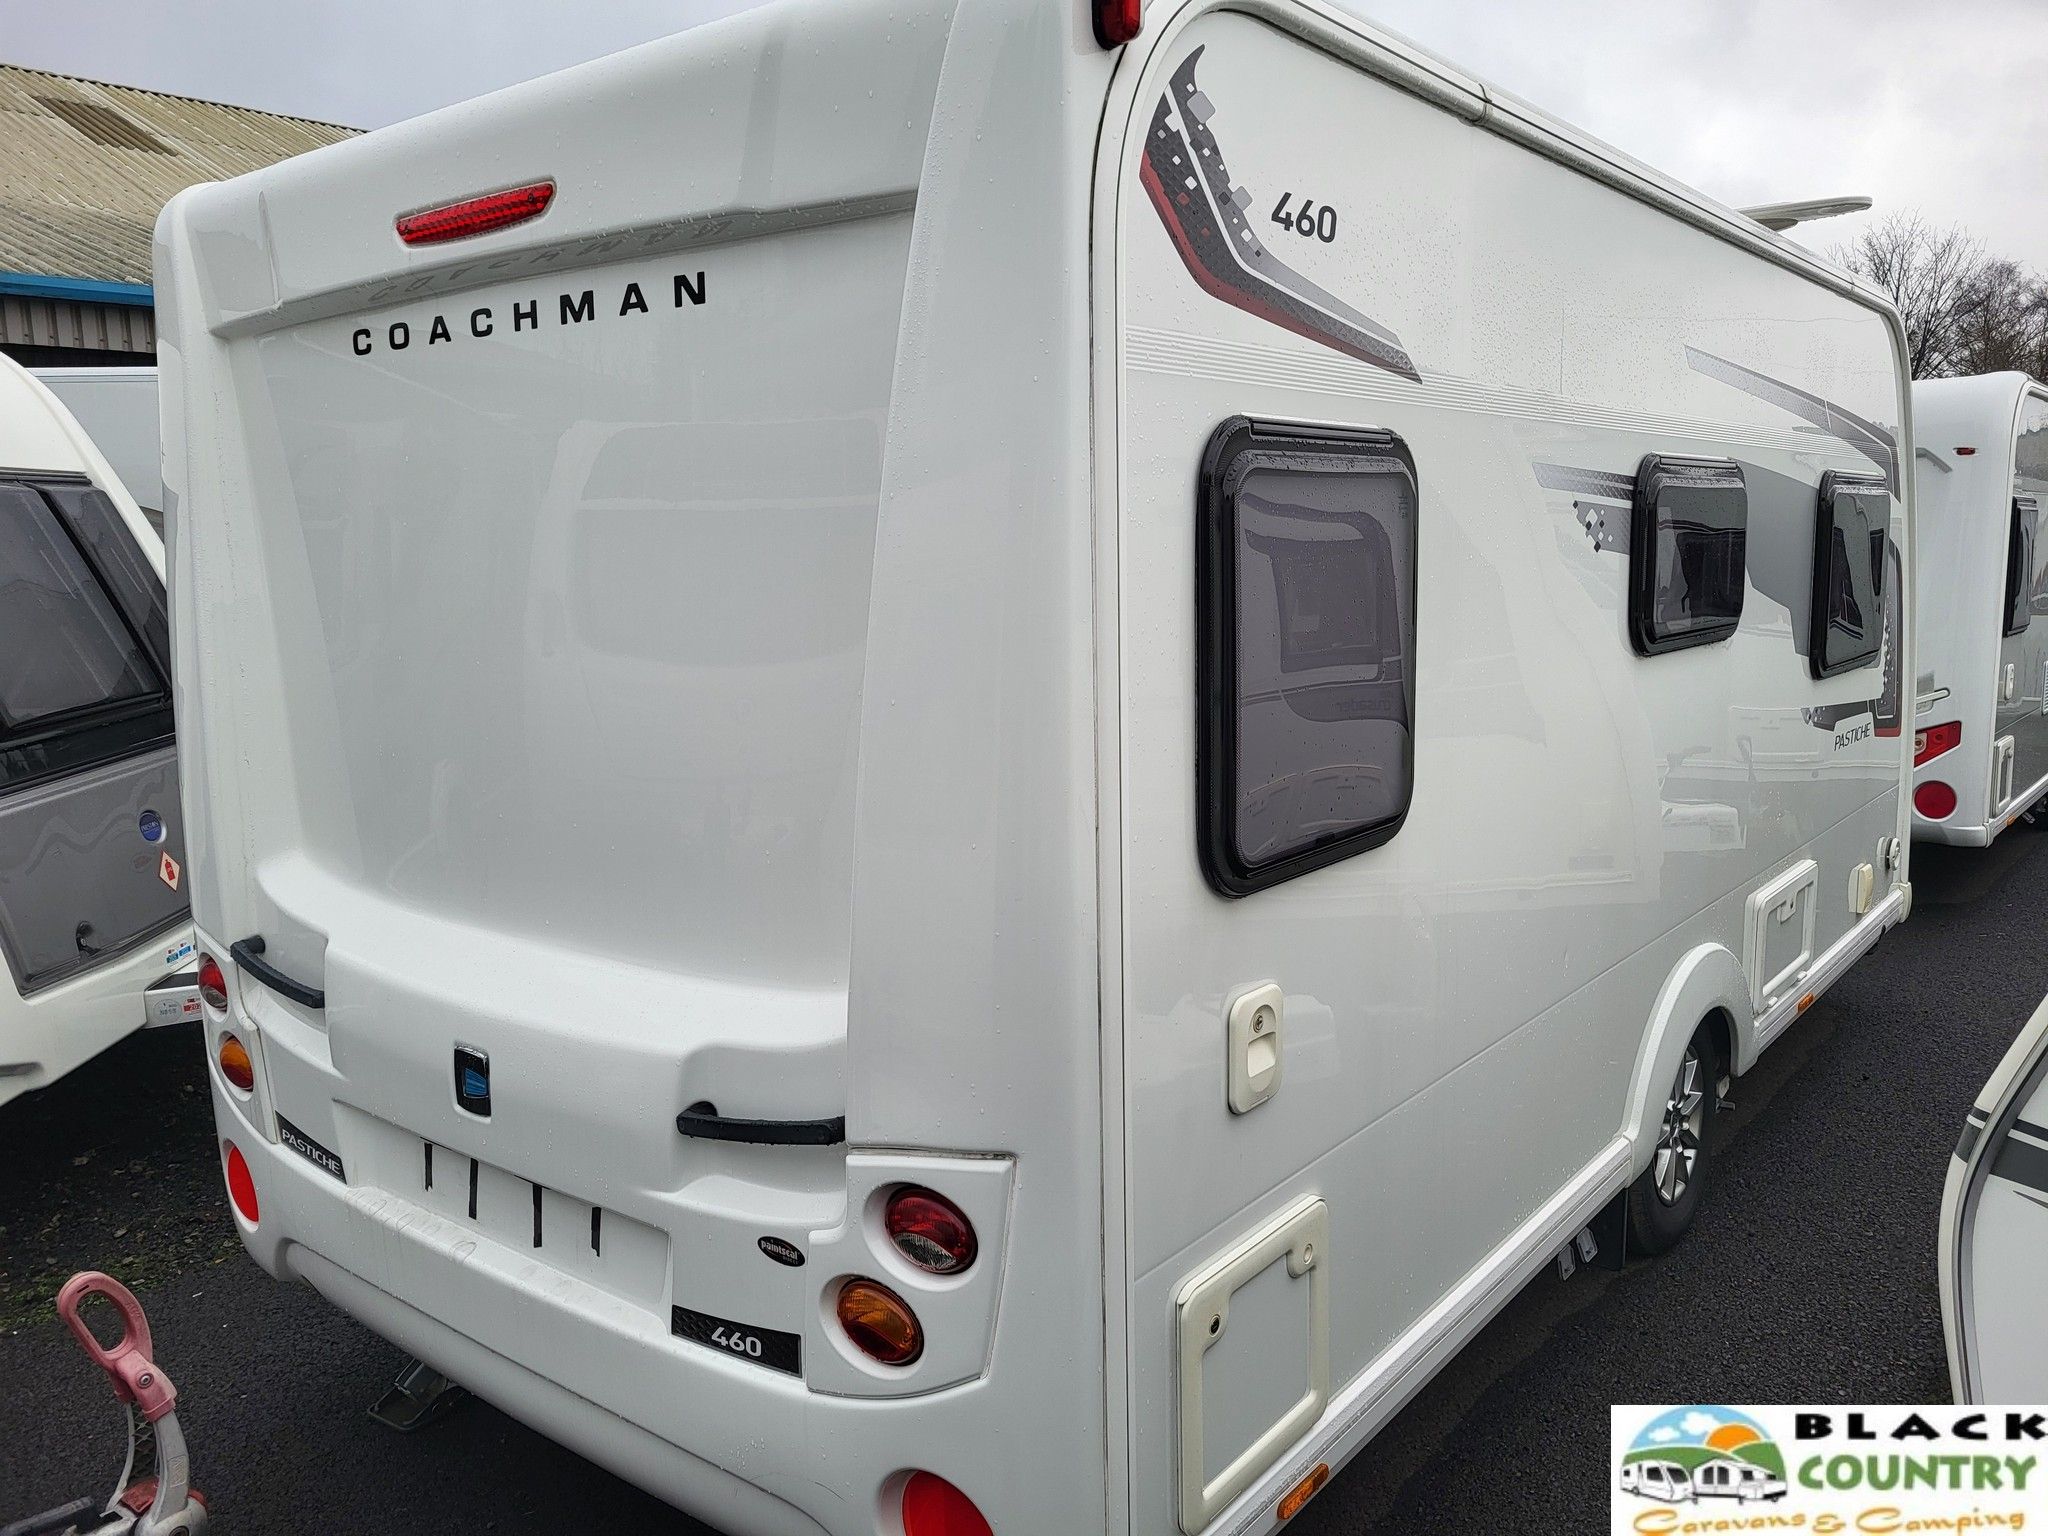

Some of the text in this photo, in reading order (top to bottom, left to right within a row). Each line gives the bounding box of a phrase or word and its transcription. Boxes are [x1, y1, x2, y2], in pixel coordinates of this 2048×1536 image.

[1271, 192, 1337, 243] 460
[352, 271, 707, 356] COACHMAN
[1834, 722, 1872, 751] PASTICHE
[282, 1129, 341, 1175] PASTICHE
[711, 1326, 763, 1357] 460
